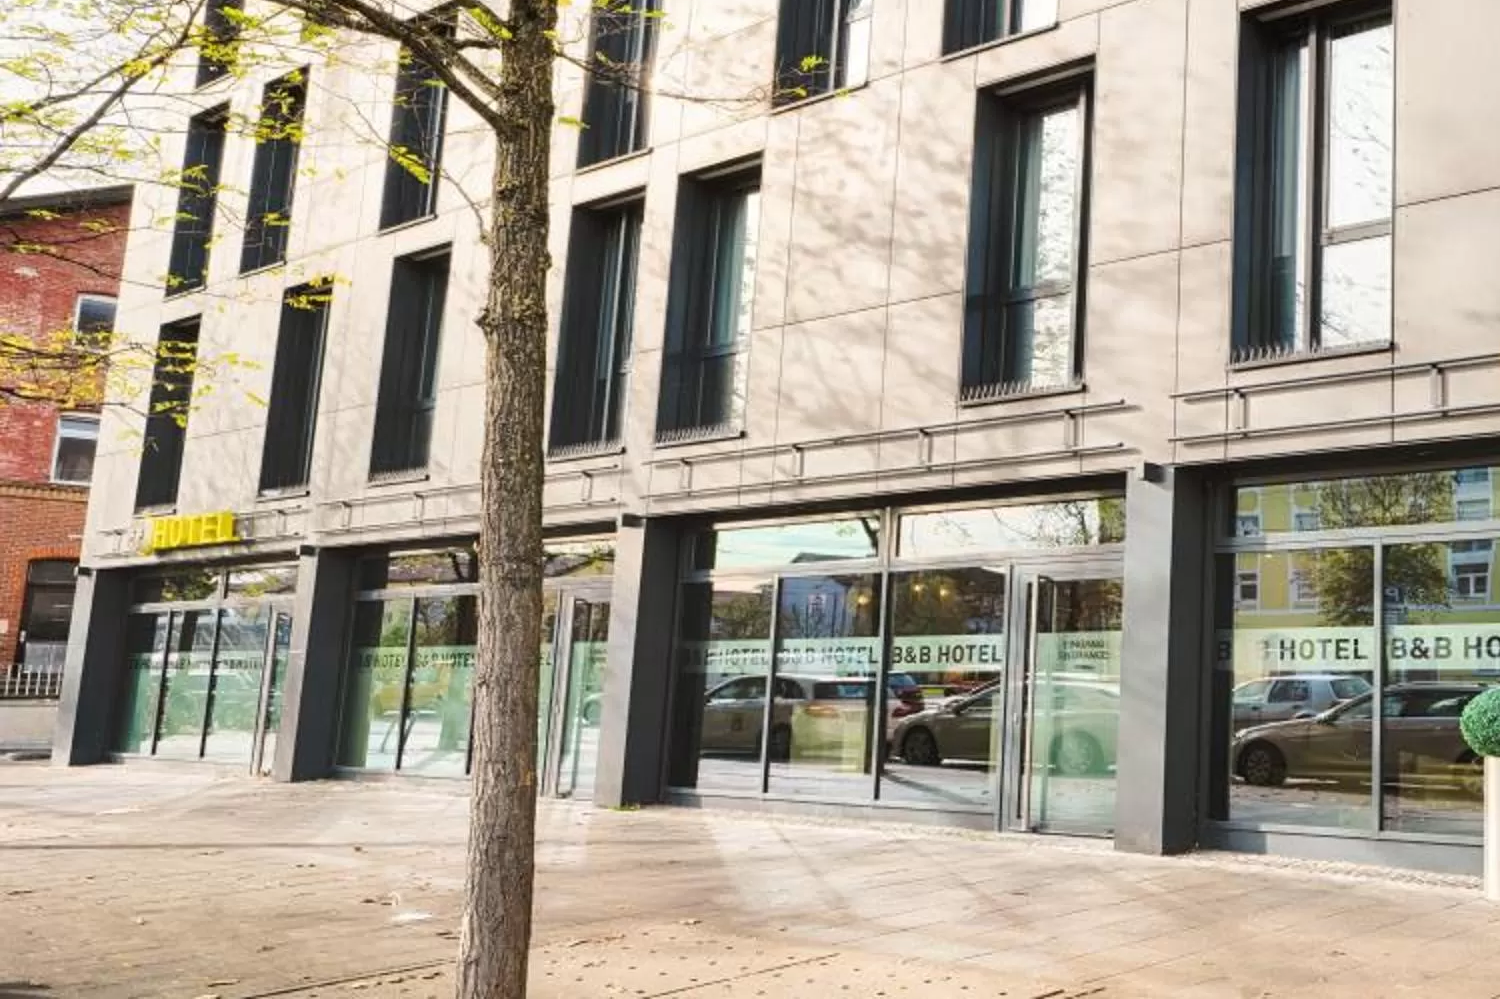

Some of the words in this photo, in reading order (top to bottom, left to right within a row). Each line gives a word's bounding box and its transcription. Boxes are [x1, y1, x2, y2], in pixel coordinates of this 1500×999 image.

[151, 509, 240, 550] HOTEL
[822, 646, 878, 665] HOTEL
[892, 645, 931, 664] B&B
[937, 643, 1003, 663] HOTEL
[1279, 638, 1369, 661] HOTEL
[1390, 636, 1453, 660] B&B
